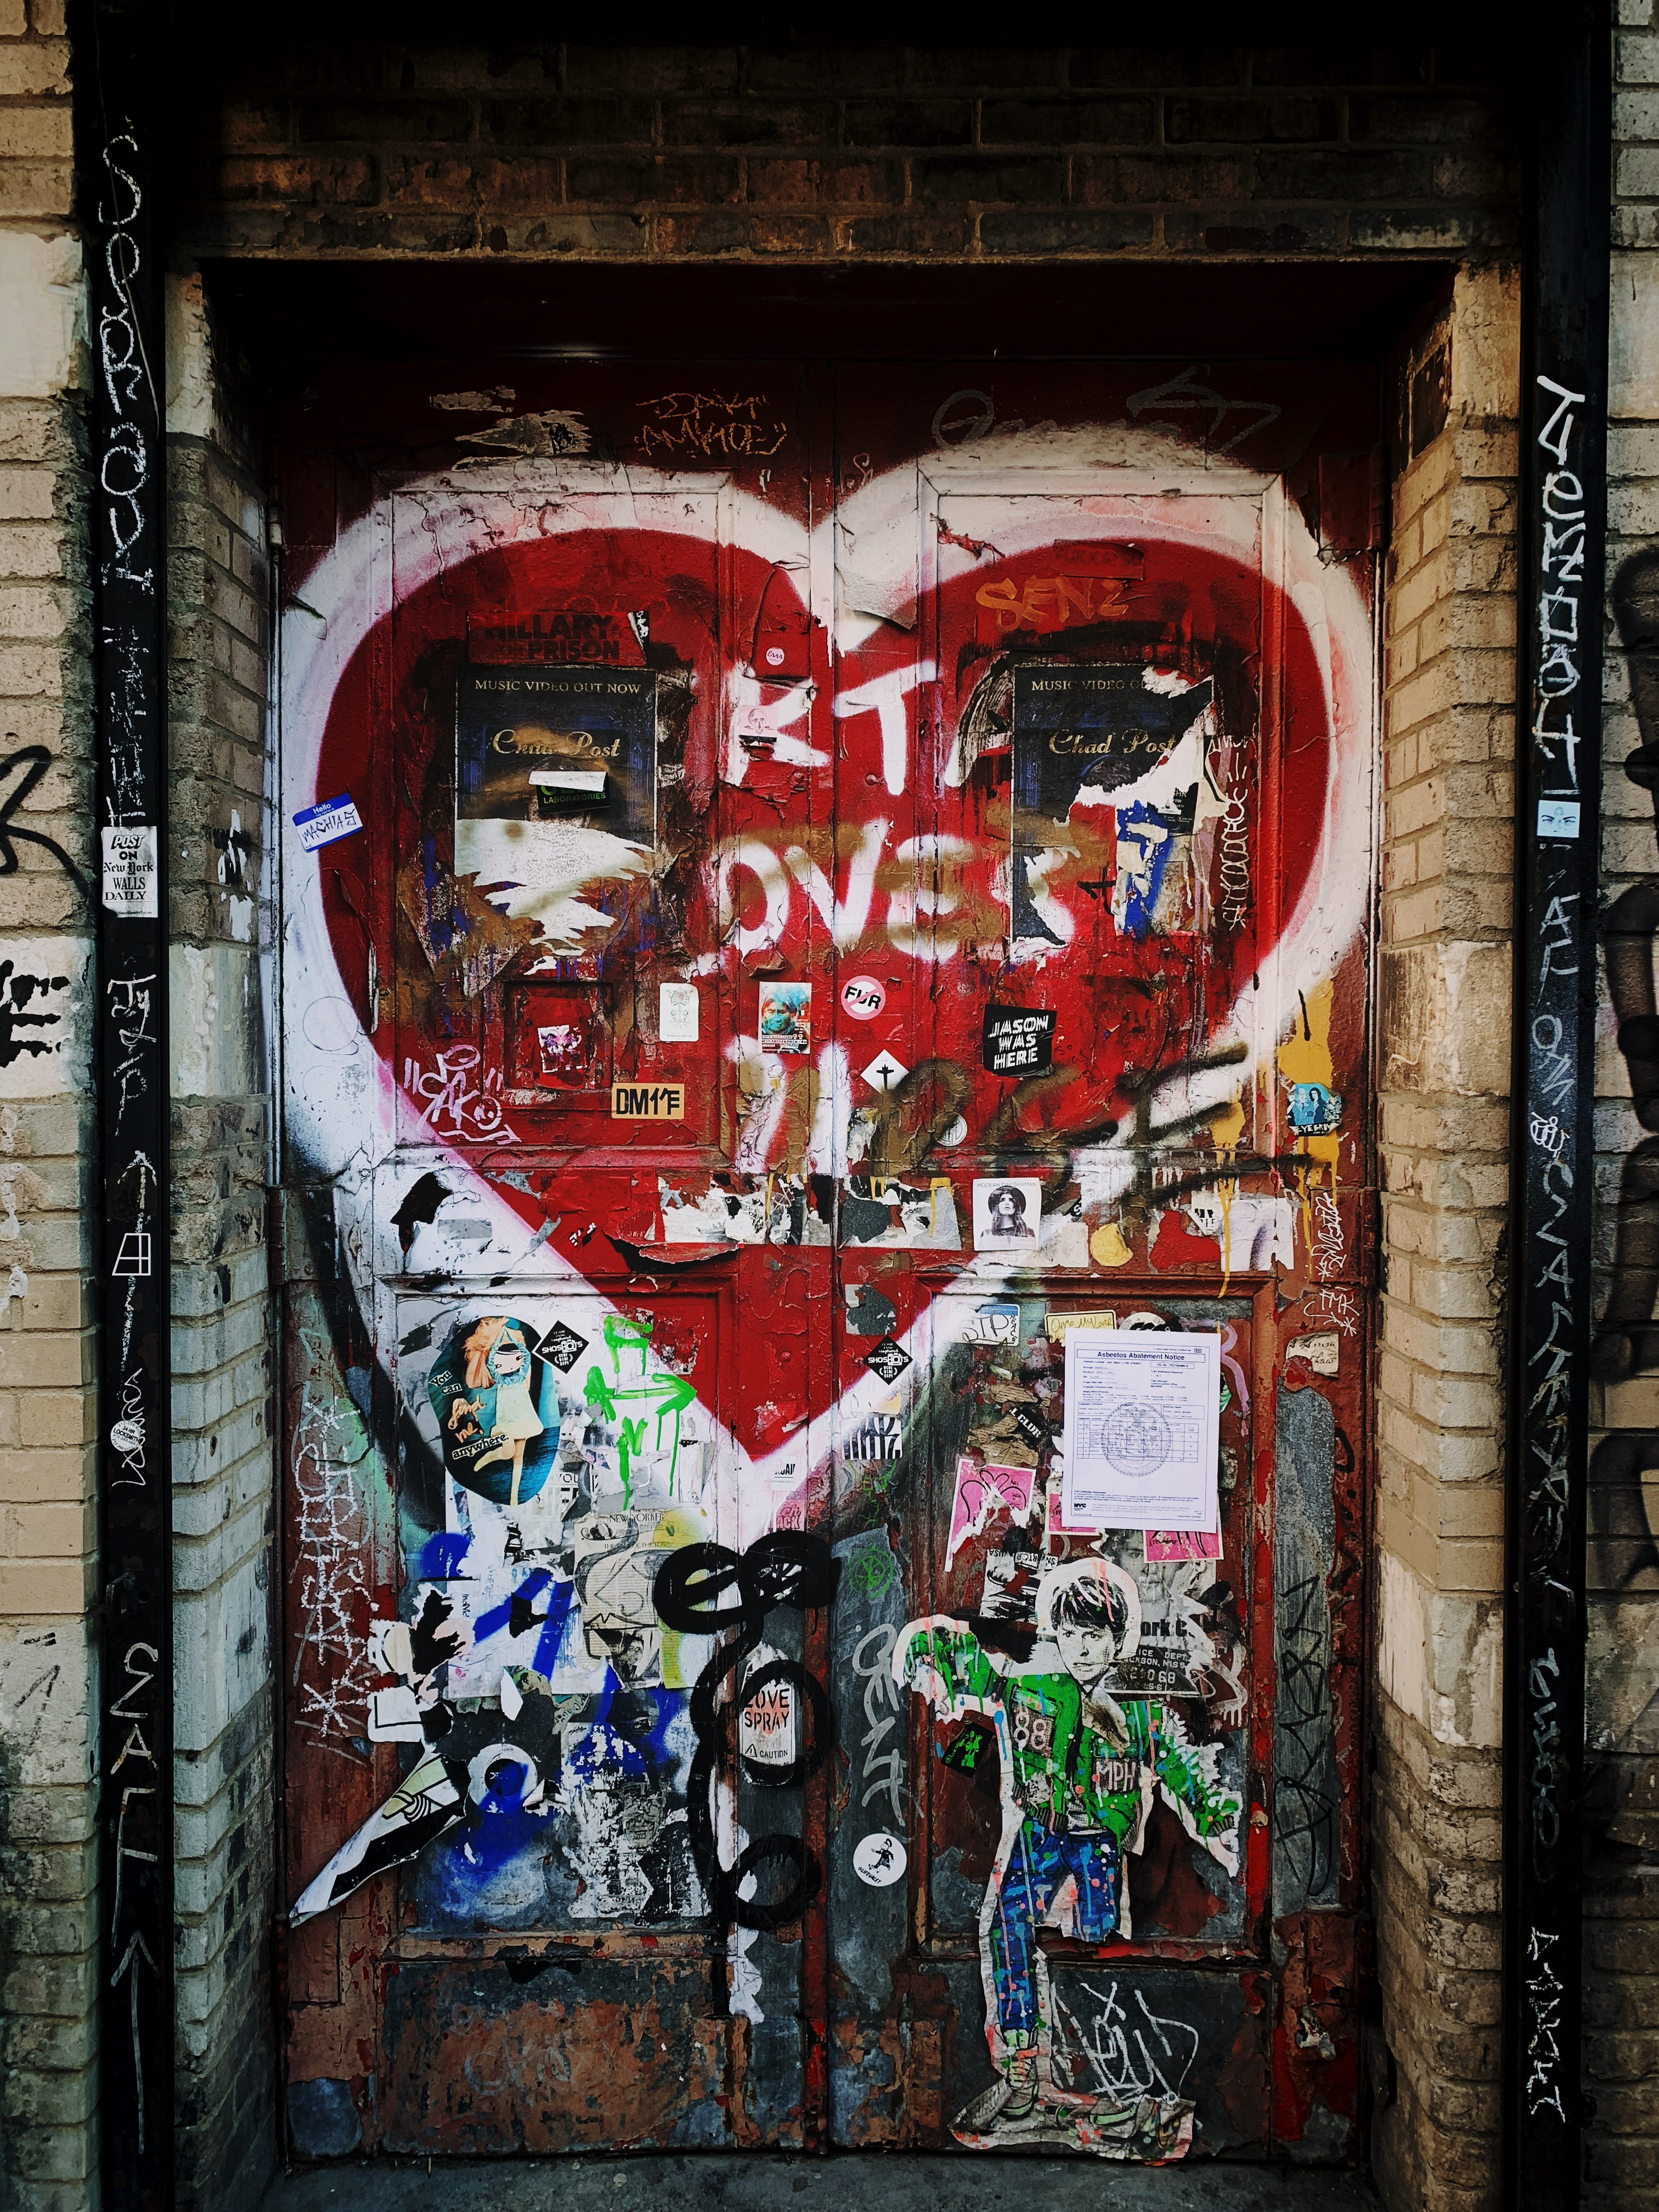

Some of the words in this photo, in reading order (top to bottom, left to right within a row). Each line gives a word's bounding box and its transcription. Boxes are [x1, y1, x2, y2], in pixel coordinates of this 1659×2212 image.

[527, 640, 620, 659] PRISON
[475, 680, 521, 691] MUSIC
[524, 681, 569, 692] VIDEO
[573, 682, 603, 693] OUT
[607, 684, 641, 695] NOW
[1031, 680, 1076, 691] MUSIC
[1081, 680, 1125, 690] VIDEO
[566, 731, 621, 757] Post
[1048, 729, 1114, 754] Chad
[1121, 728, 1176, 754] Post
[543, 792, 606, 804] LABORATORIES
[313, 803, 331, 815] Hello
[111, 834, 145, 849] POST
[119, 851, 138, 860] ON
[103, 862, 126, 873] New
[127, 861, 154, 875] York
[113, 877, 145, 890] WALLS
[105, 891, 146, 900] DAILY
[844, 985, 881, 1010] FUR
[988, 1015, 1049, 1038] JASON
[998, 1033, 1037, 1052] WAS
[994, 1047, 1038, 1070] HERE
[430, 1371, 453, 1386] You
[441, 1384, 461, 1394] can
[113, 1427, 139, 1443] LOCKSMITH
[453, 1434, 509, 1459] anywhere.
[610, 1515, 629, 1523] NEW
[631, 1513, 664, 1522] YORKER
[1140, 1618, 1170, 1637] ork
[744, 1711, 789, 1731] SPRAY
[1013, 1712, 1047, 1751] 88
[759, 1749, 788, 1759] CAUTION
[1096, 1760, 1136, 1792] MPH
